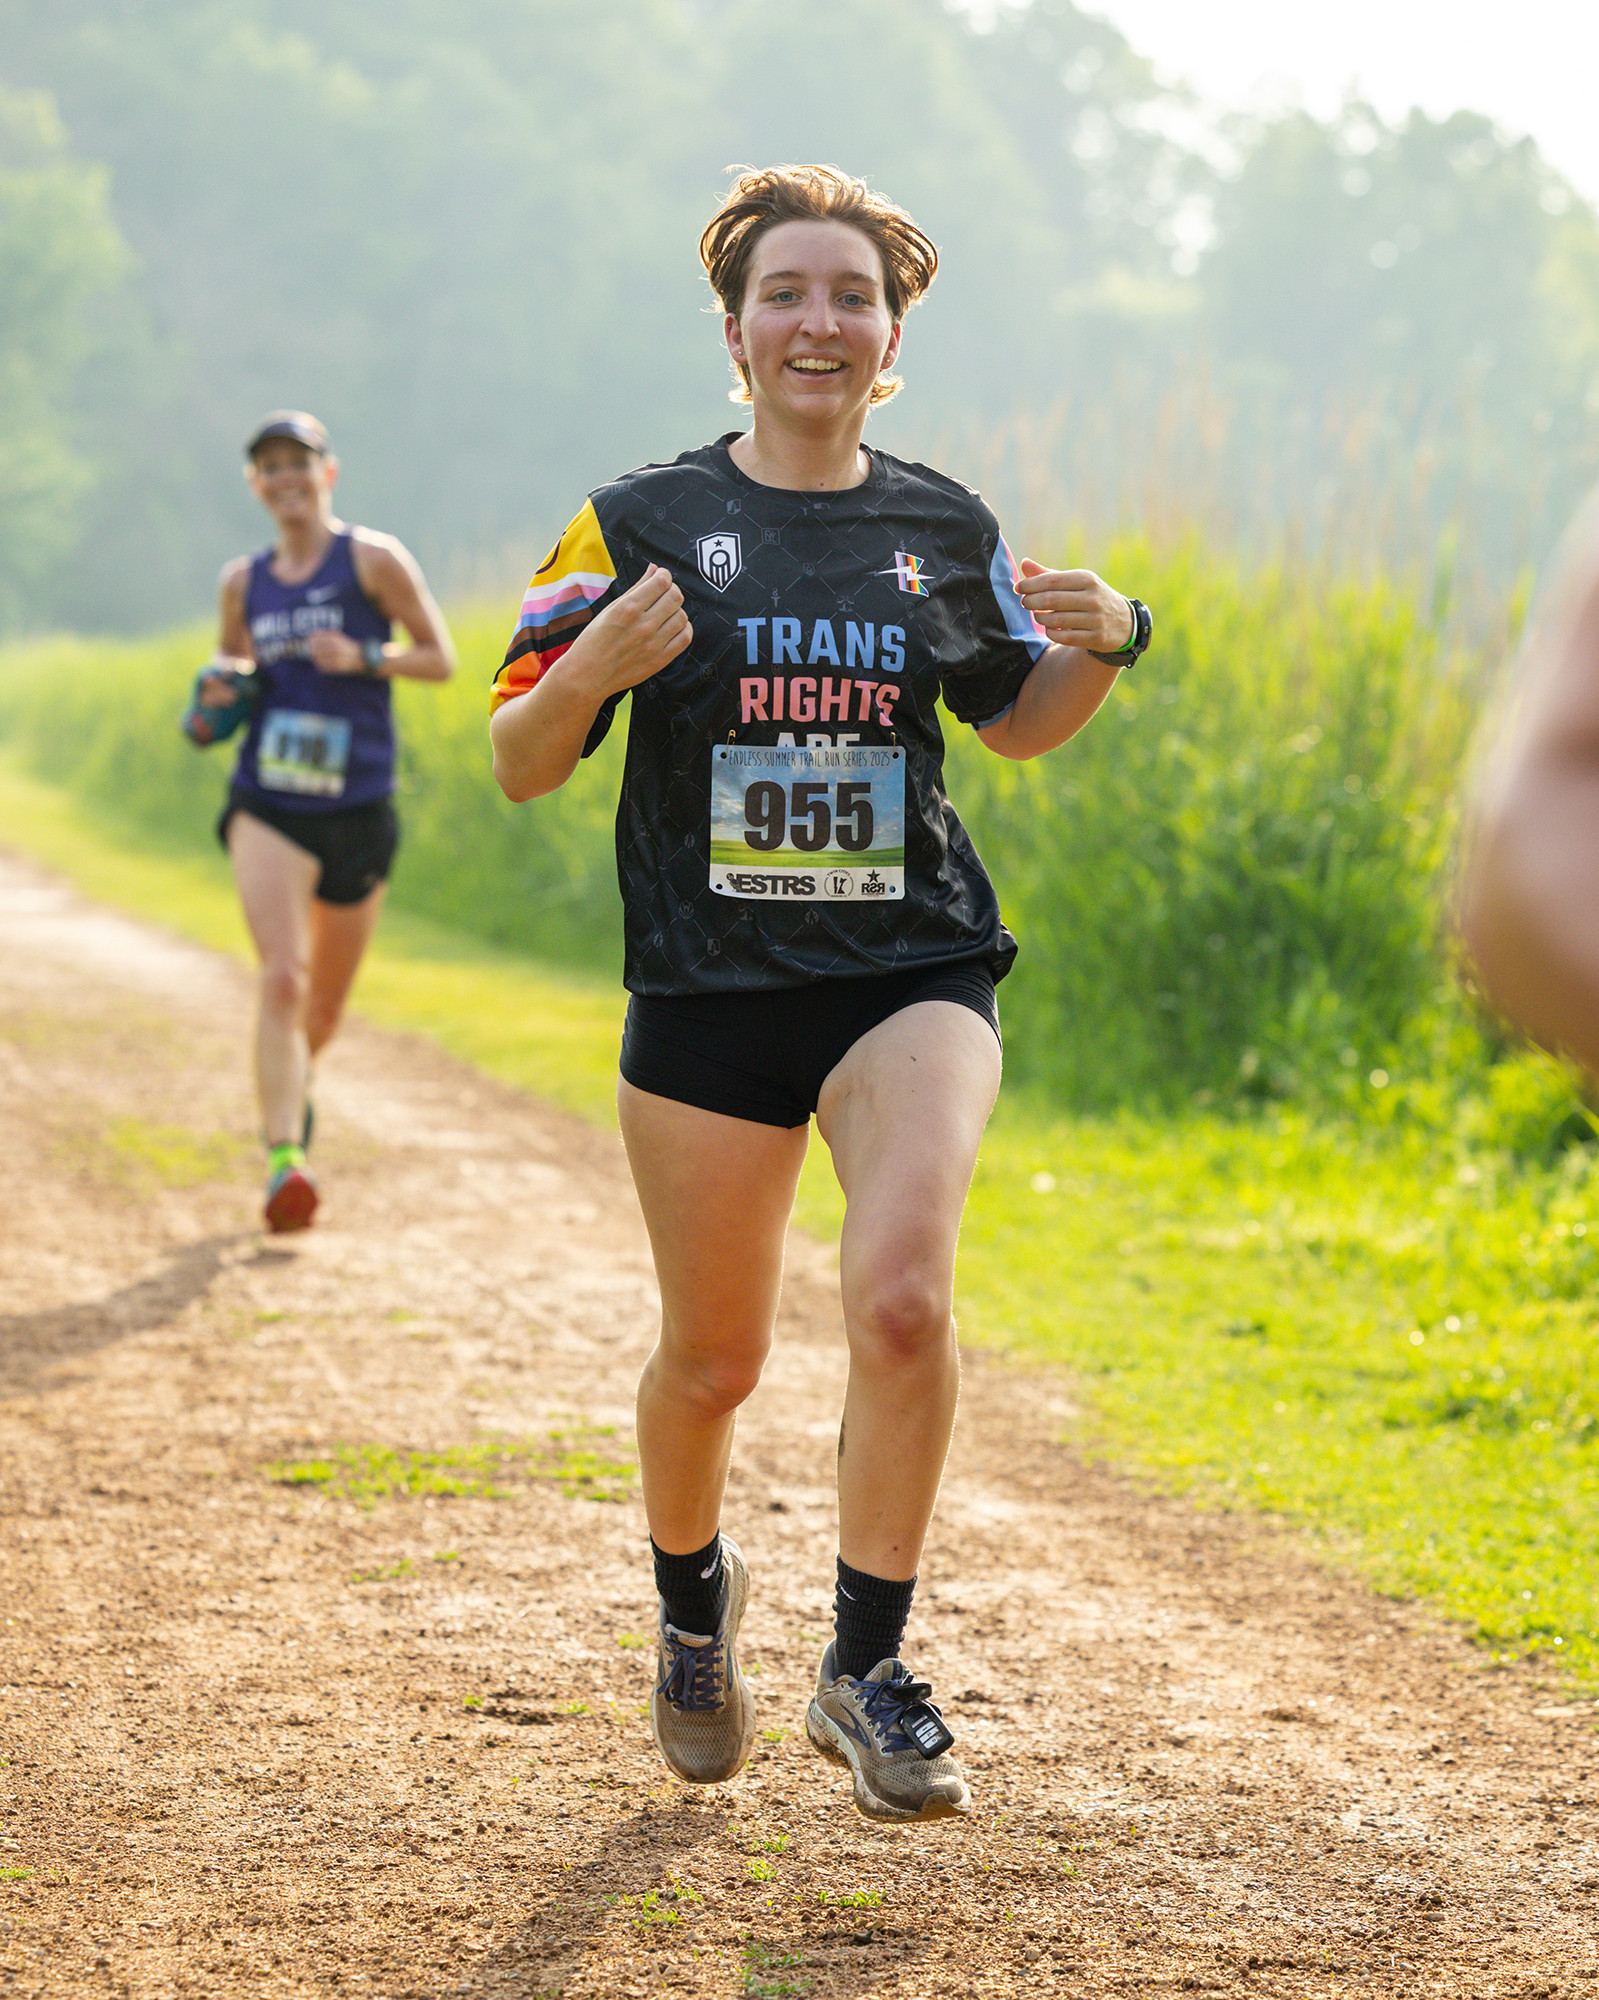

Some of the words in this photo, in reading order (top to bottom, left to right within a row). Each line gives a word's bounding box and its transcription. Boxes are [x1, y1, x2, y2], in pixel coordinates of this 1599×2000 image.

[737, 616, 906, 673] TRANS
[739, 676, 901, 727] RIGHTS
[728, 750, 762, 767] ENDLESS
[764, 750, 796, 767] SUMMER
[799, 751, 821, 768] TRAIL
[825, 751, 841, 767] RUN
[843, 751, 868, 767] SERIES
[870, 751, 891, 767] 2025
[744, 780, 874, 851] 955
